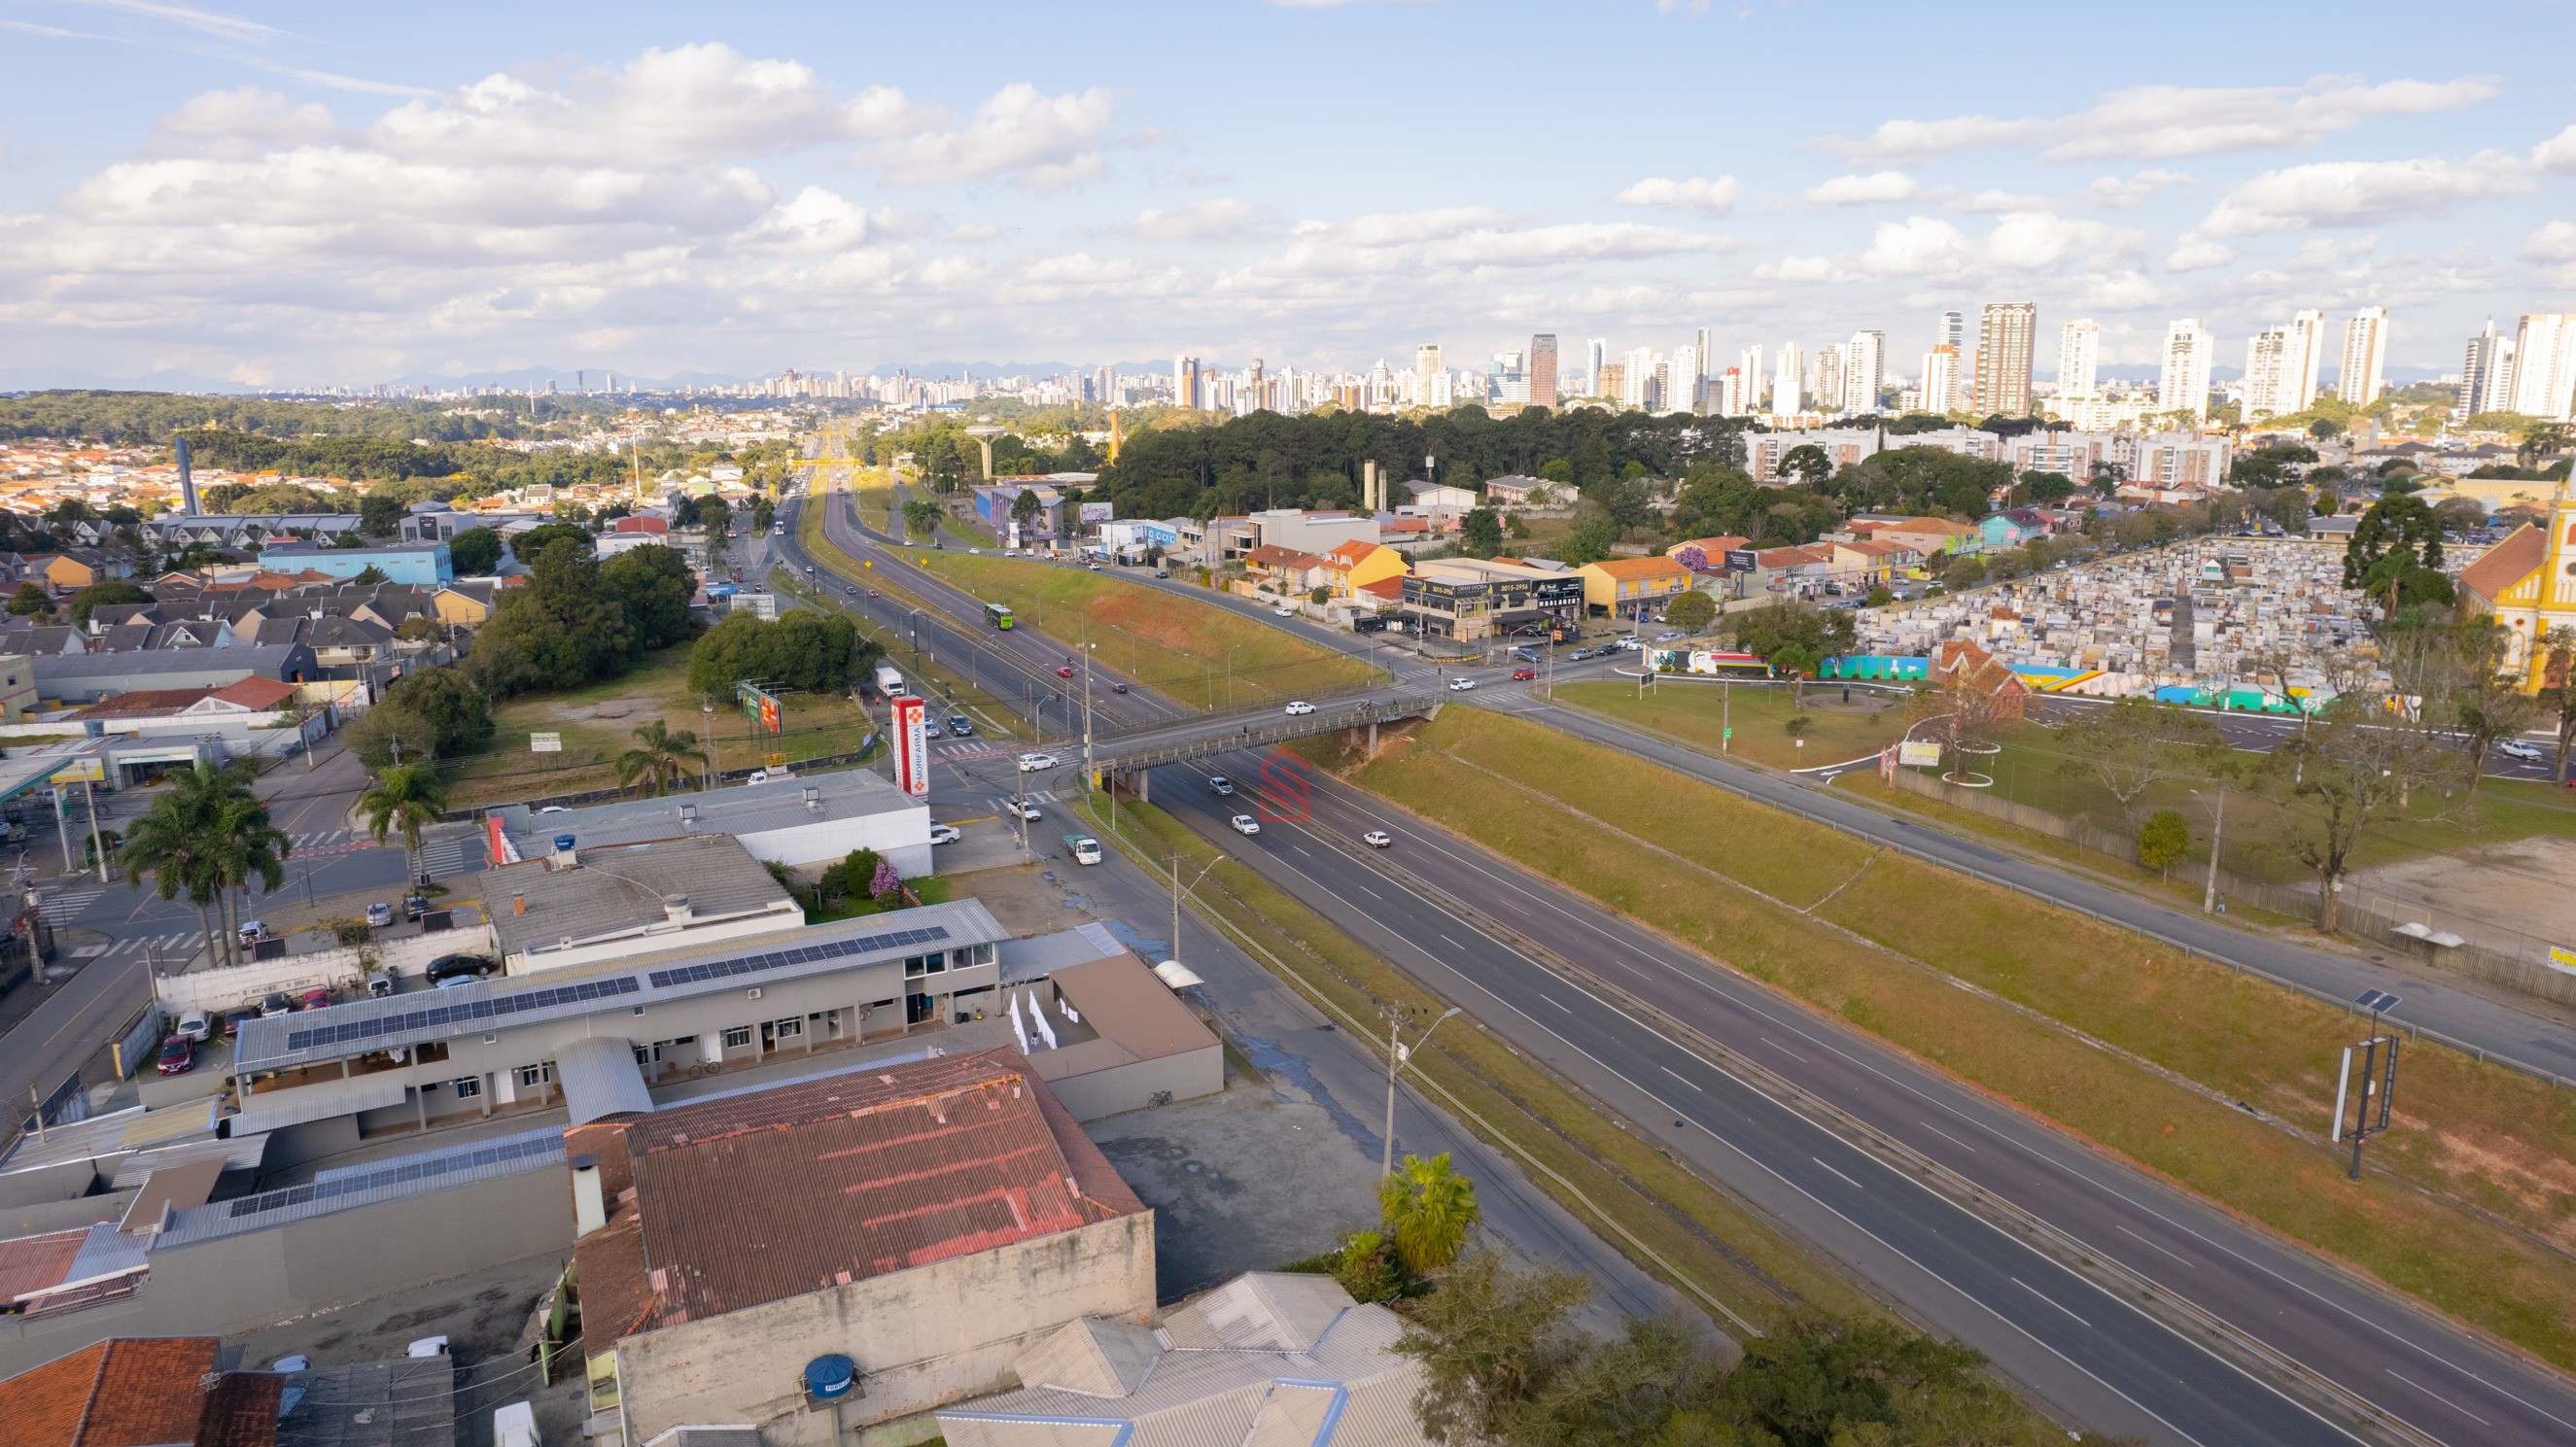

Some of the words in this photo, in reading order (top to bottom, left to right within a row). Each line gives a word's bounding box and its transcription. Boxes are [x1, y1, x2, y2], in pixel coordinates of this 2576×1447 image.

[1432, 586, 1453, 595] 3015-3956
[1500, 583, 1528, 592] 3015-3956
[914, 727, 922, 779] MORIFARMA
